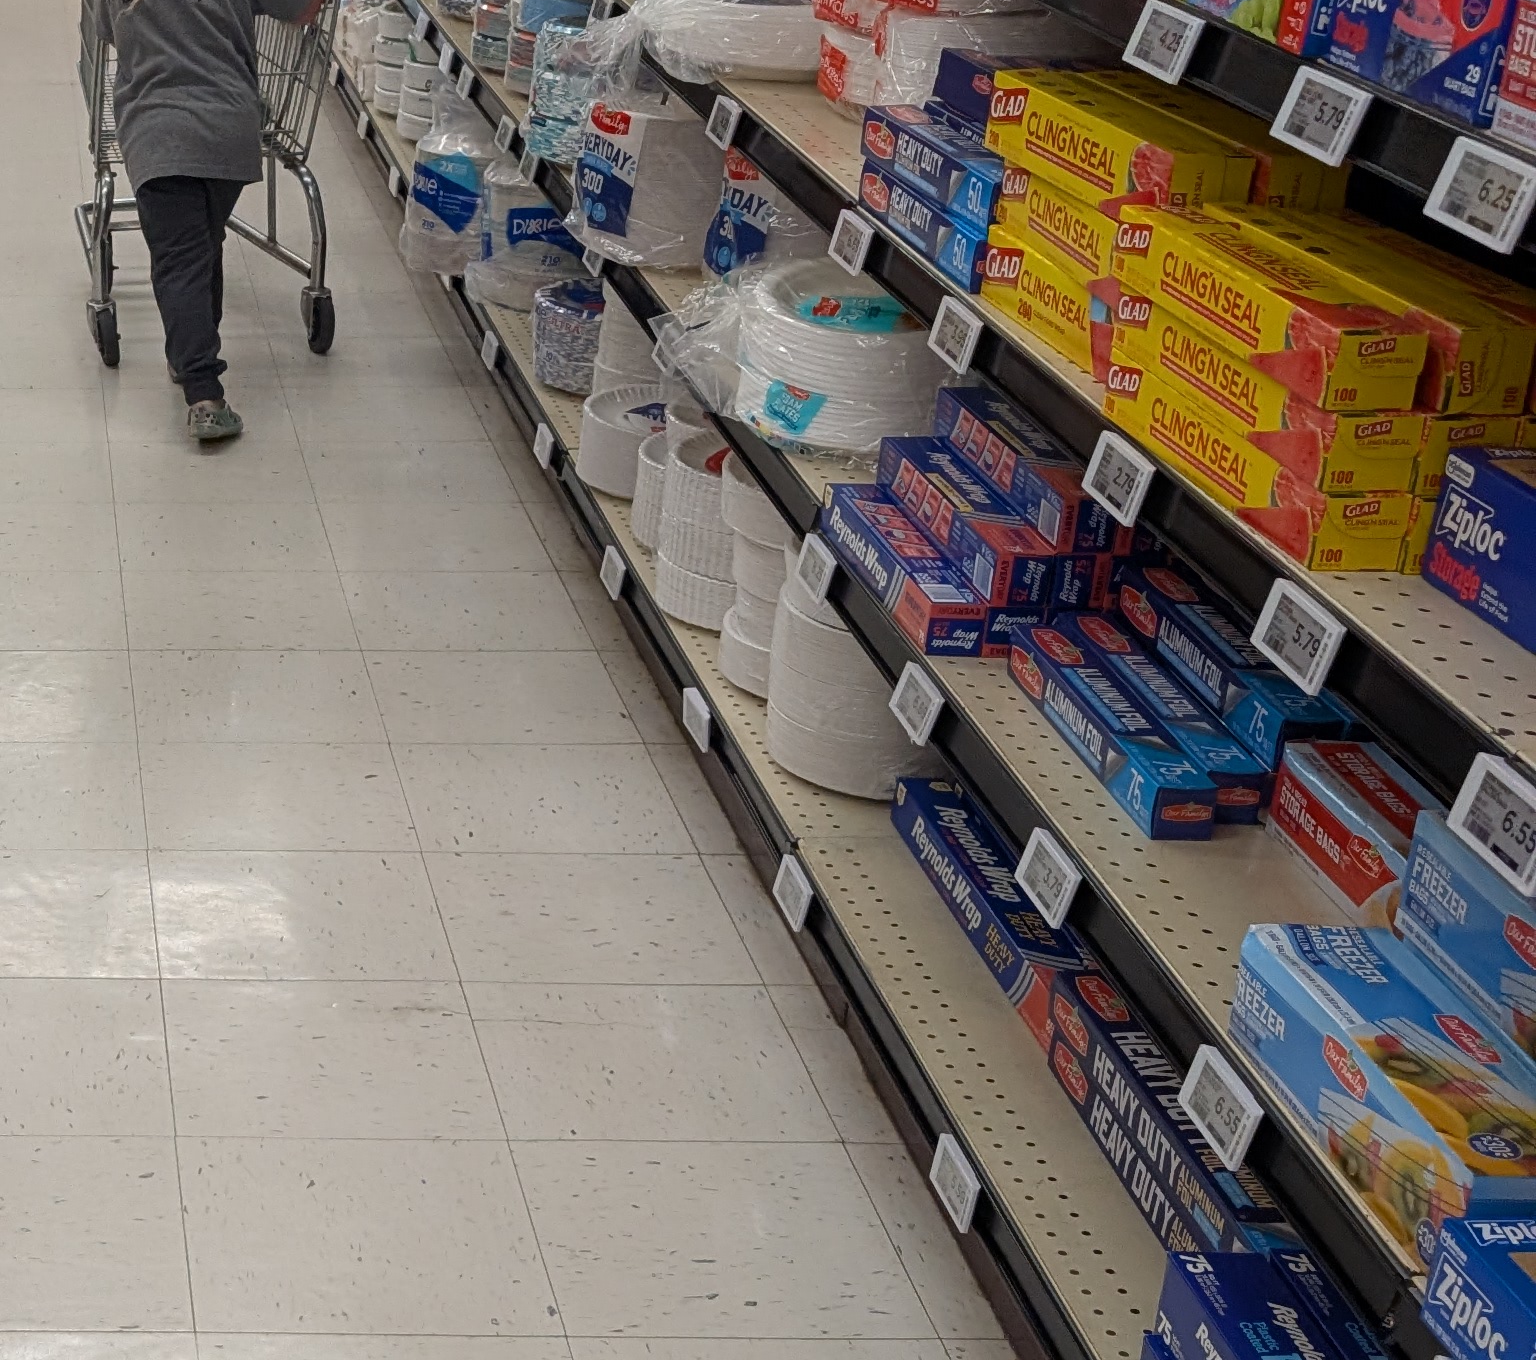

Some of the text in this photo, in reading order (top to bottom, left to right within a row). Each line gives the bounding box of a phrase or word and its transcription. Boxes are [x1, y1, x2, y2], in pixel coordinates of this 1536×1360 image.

[1159, 29, 1183, 54] 4.25
[1465, 64, 1481, 83] 29
[990, 92, 1025, 119] GLAD
[1314, 102, 1345, 130] 5.79
[1026, 110, 1117, 179] CLING'N SEAL
[581, 168, 603, 194] 300
[967, 176, 982, 213] 50
[1477, 179, 1517, 212] 6.25
[421, 219, 435, 229] 210
[540, 255, 561, 266] 210
[953, 237, 966, 269] 50
[985, 249, 1022, 278] GLAD
[1118, 296, 1151, 321] GLAD
[1163, 251, 1262, 335] CLING'N SEAL
[1108, 365, 1140, 392] GLAD
[1161, 325, 1259, 412] CLING'N SEAL
[778, 390, 805, 409] FOAM
[1332, 388, 1357, 402] 100
[773, 403, 802, 425] PLATES
[1113, 466, 1135, 495] 2.79
[1330, 471, 1354, 484] 100
[1442, 493, 1504, 561] Ziploc
[829, 506, 888, 590] Reynolds Wrap
[1319, 549, 1343, 562] 100
[1432, 542, 1481, 601] Storage
[1292, 624, 1320, 658] 5.79
[1045, 679, 1103, 761] ALUMINUM FOIL
[1279, 785, 1341, 865] STORAGE BAGS
[1502, 810, 1536, 854] 6.55
[911, 816, 982, 933] Reynolds Wrap
[1416, 844, 1453, 883] RESEALABLE
[1043, 868, 1064, 898] 3.79
[1408, 881, 1429, 906] BAGS
[1411, 859, 1469, 924] FREEZER
[984, 942, 1006, 973] DUTY
[985, 923, 1015, 965] HEAVY
[1323, 925, 1389, 985] FREEZER
[1092, 1043, 1182, 1188] HEAVY DUTY
[1214, 1097, 1238, 1136] 6.55
[1090, 1094, 1176, 1240] HEAVY DUTY
[1176, 1182, 1194, 1214] FOIL
[1178, 1166, 1225, 1236] ALUMINUM
[1178, 1254, 1213, 1274] 75
[1281, 1254, 1315, 1274] 75
[1239, 1322, 1266, 1360] Coated
[1252, 1321, 1281, 1351] Plastic
